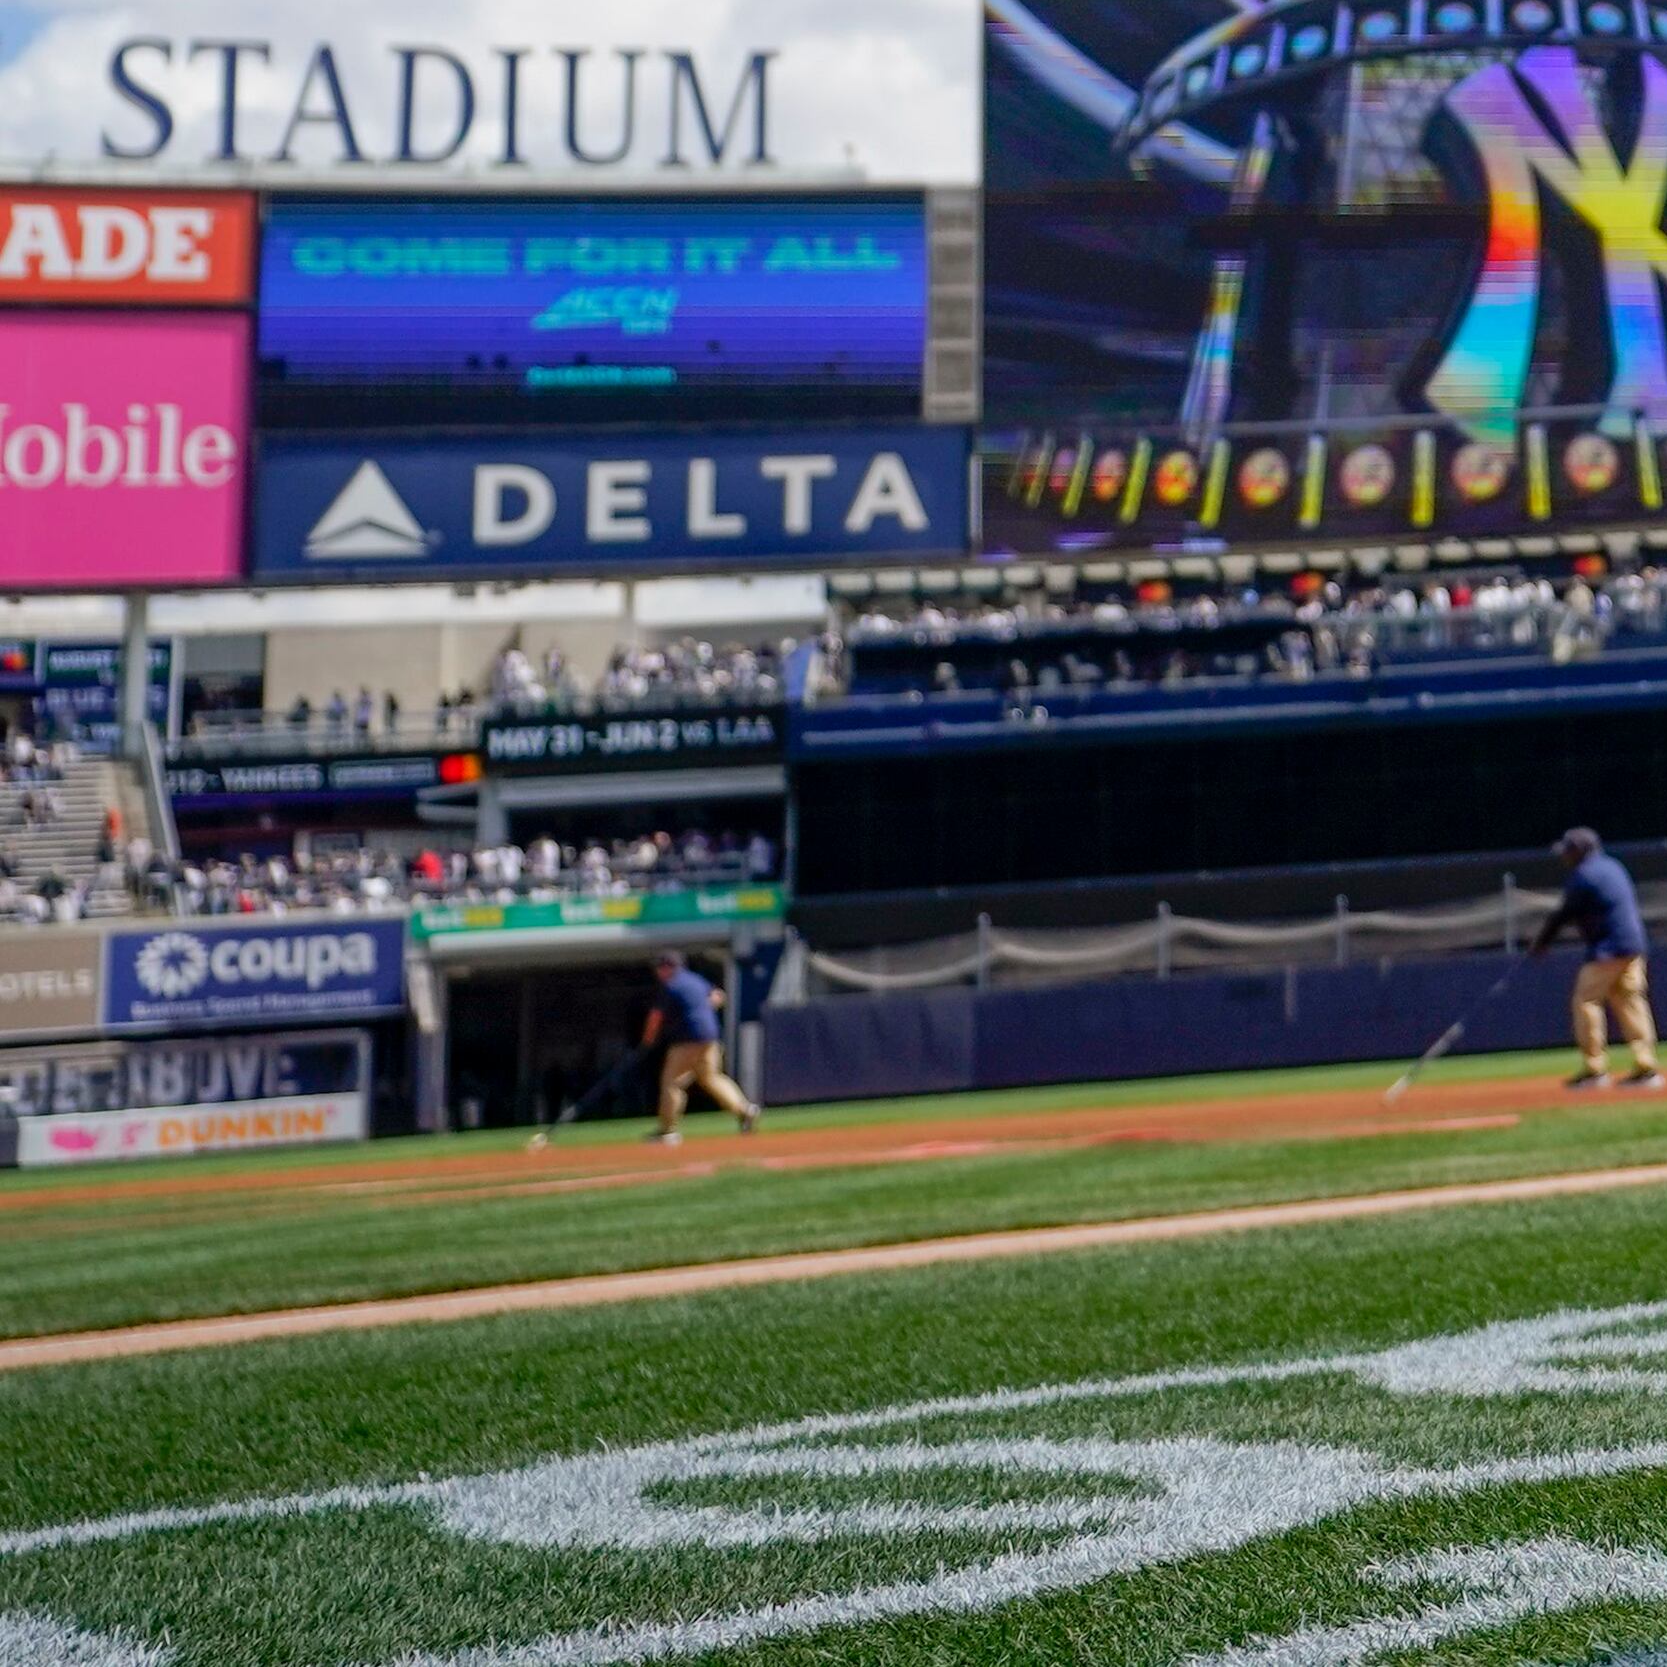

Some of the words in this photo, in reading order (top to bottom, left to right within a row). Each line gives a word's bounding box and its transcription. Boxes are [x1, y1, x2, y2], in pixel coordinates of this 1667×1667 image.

[101, 37, 780, 166] STADIUM
[524, 235, 672, 276] FOR
[685, 236, 750, 273] IT
[762, 234, 898, 272] ALL
[473, 452, 929, 547] DELTA
[600, 720, 657, 754] JUN
[658, 718, 679, 752] 2
[717, 714, 774, 743] LAA
[209, 932, 378, 990] coupa
